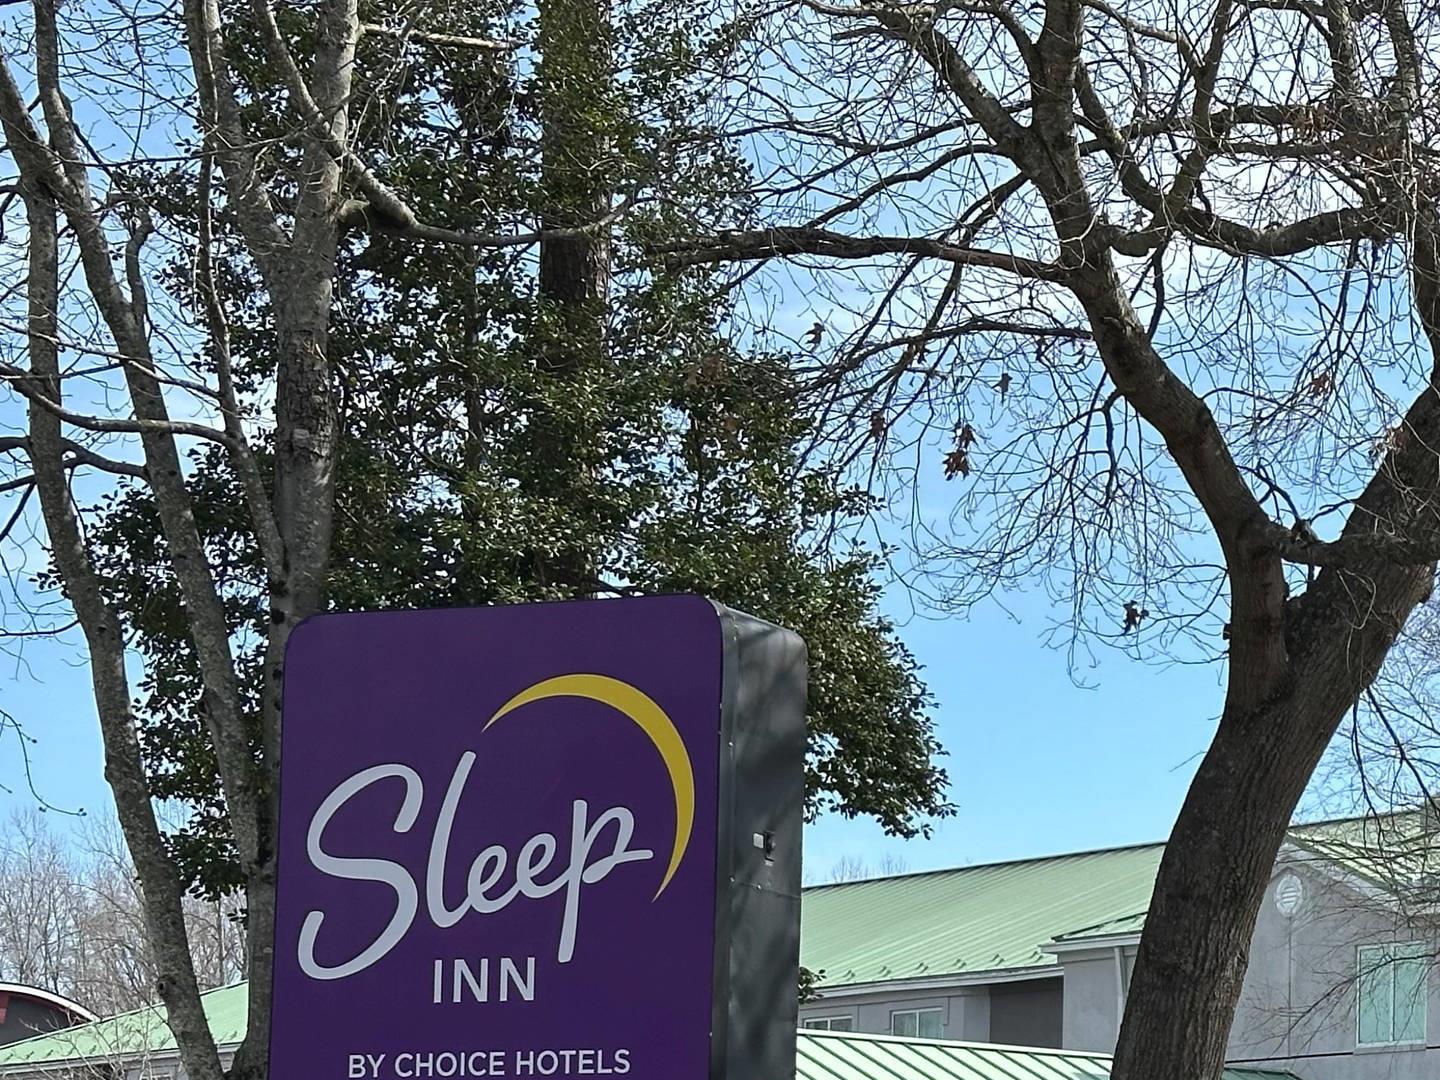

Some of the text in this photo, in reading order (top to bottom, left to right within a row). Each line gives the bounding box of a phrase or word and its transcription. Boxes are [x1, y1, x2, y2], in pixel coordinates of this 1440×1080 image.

[298, 750, 654, 980] Sleep
[433, 957, 537, 1004] INN
[348, 1049, 631, 1078] BY CHOICE HOTELS
